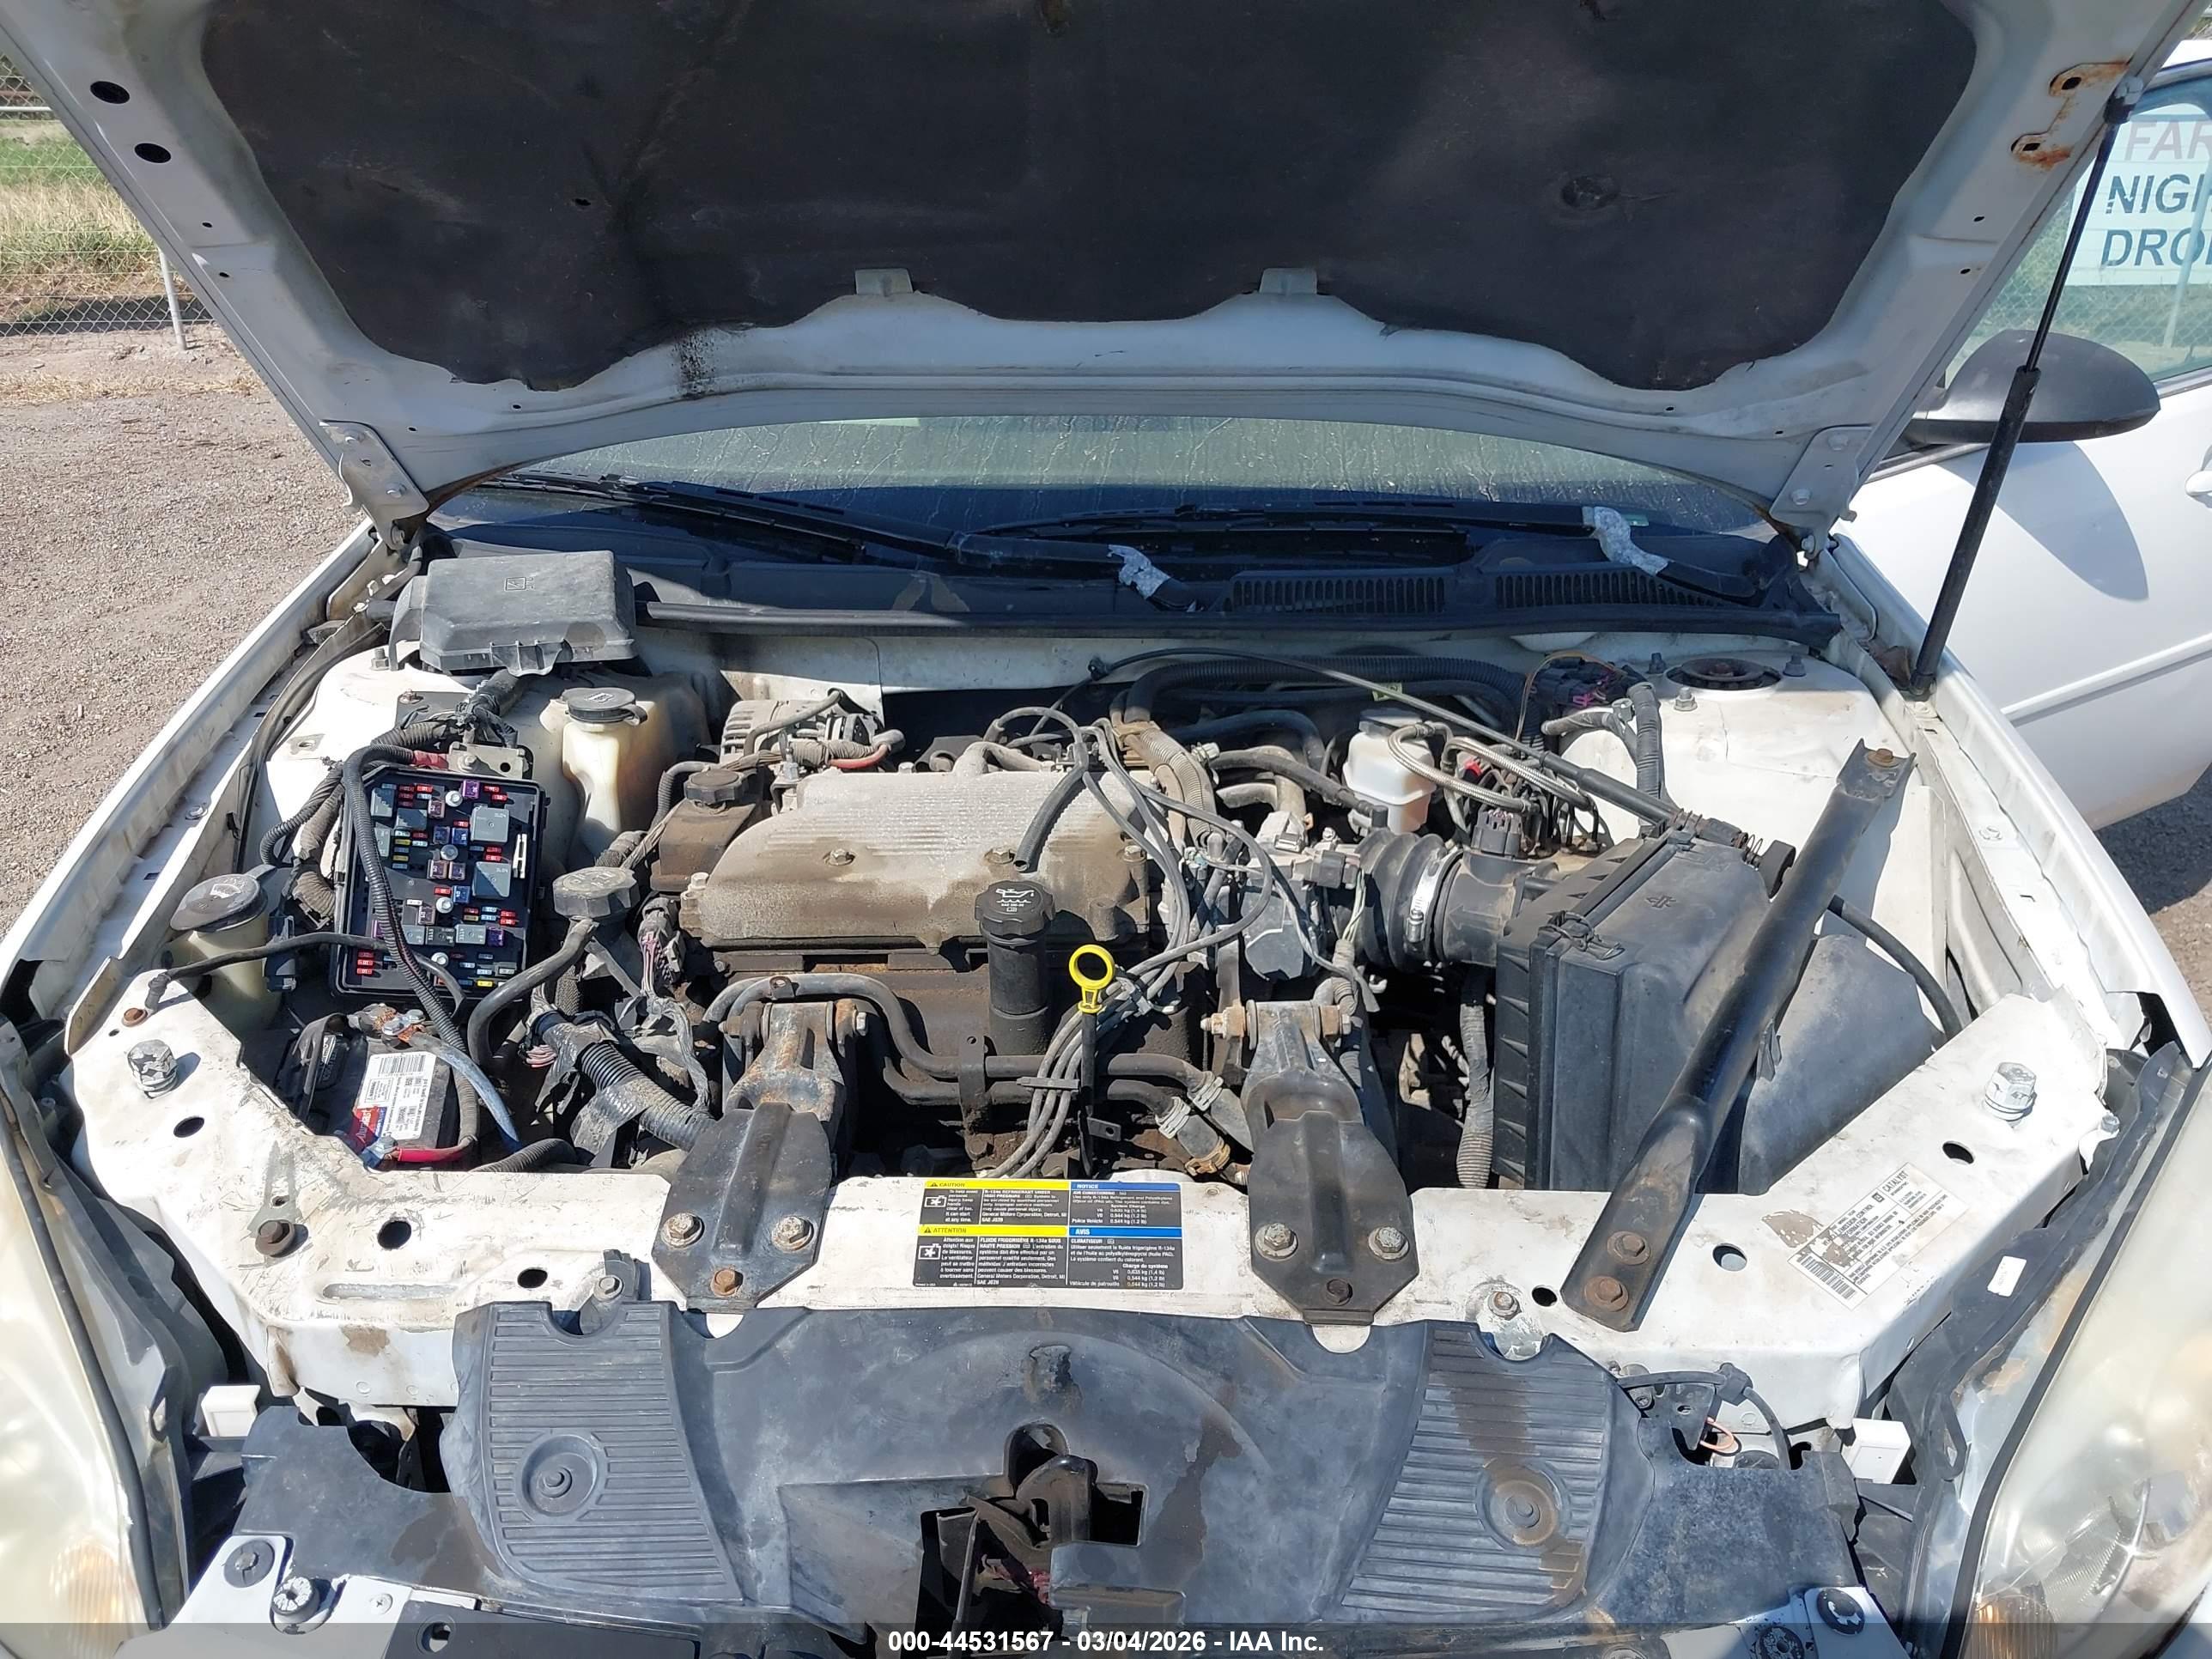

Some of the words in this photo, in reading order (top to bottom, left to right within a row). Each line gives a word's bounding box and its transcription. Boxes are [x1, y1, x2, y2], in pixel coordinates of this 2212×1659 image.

[2106, 174, 2212, 214] NIG
[2101, 228, 2212, 267] DRO
[1882, 1170, 1908, 1192] CATALYST
